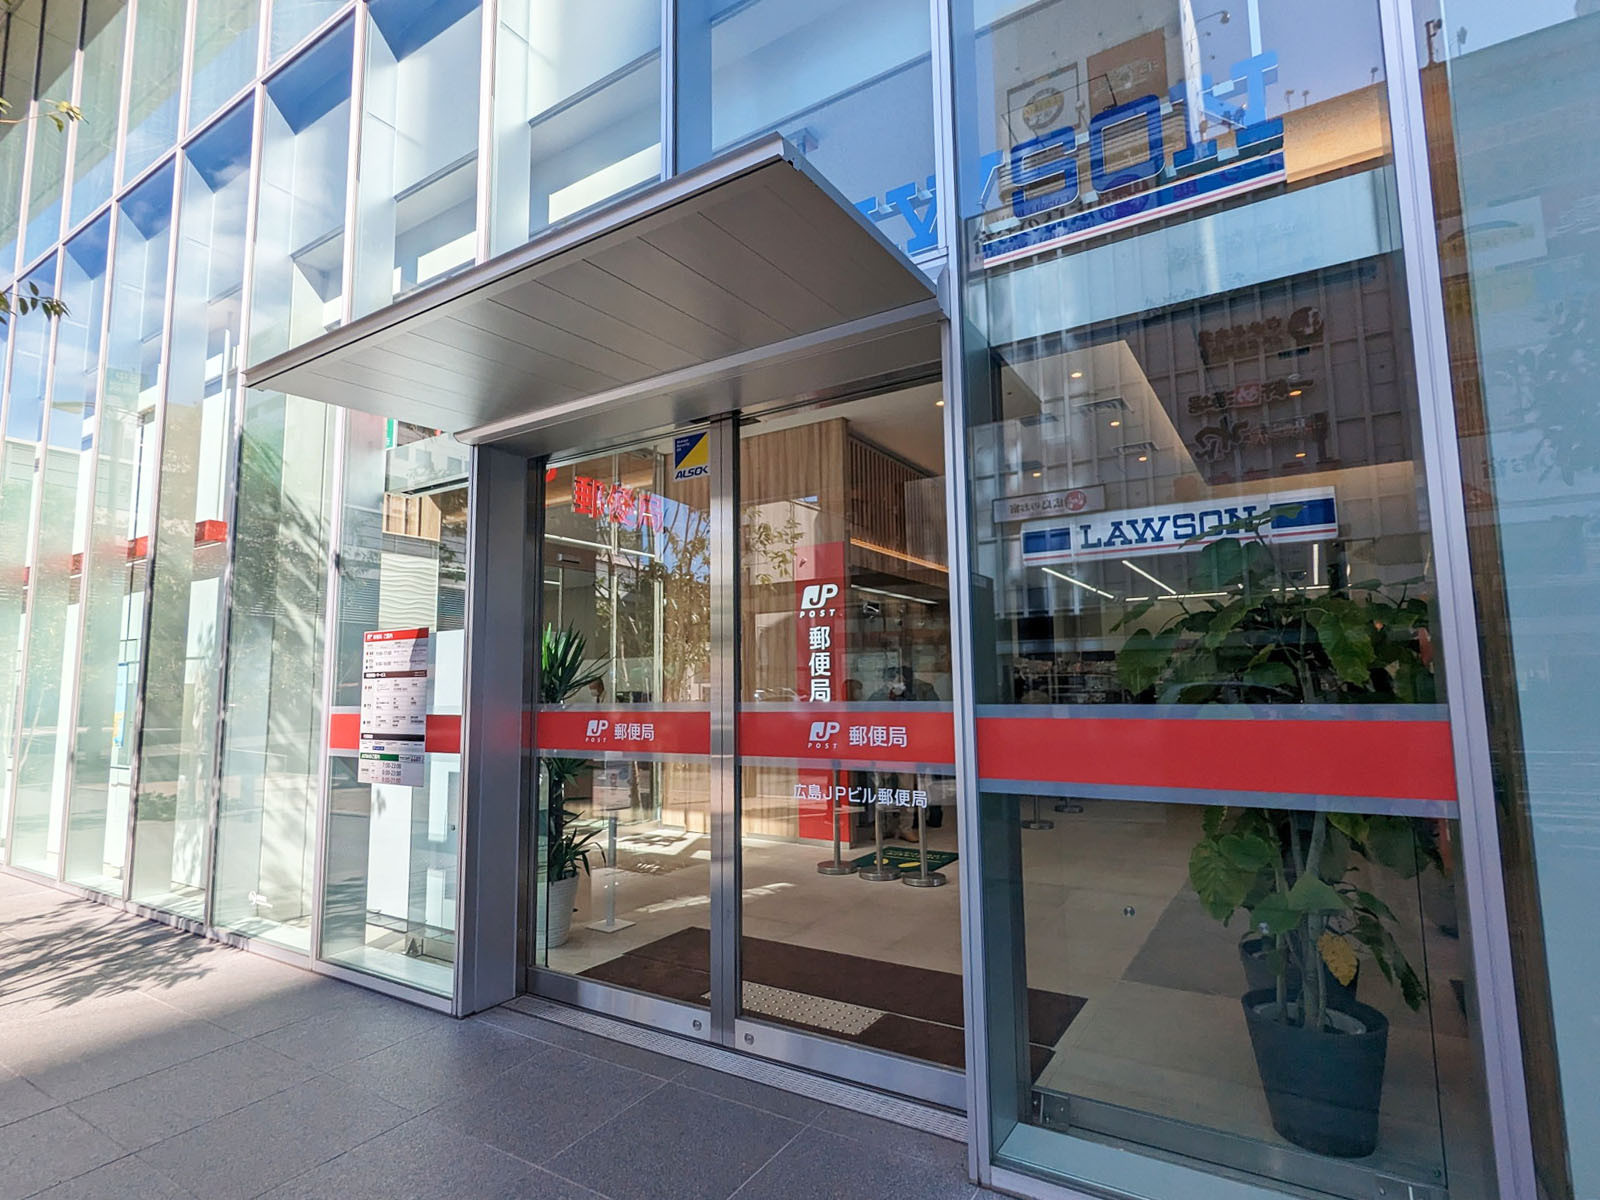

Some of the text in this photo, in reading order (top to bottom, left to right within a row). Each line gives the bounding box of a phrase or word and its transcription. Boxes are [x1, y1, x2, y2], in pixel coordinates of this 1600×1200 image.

[675, 465, 708, 480] ALSOK
[1080, 505, 1257, 549] LAWSON
[799, 608, 836, 618] POST
[808, 626, 832, 703] 郵便局
[613, 723, 655, 742] 郵便局
[848, 725, 908, 748] 郵便局
[793, 783, 928, 809] 広島JPビル郵便局
